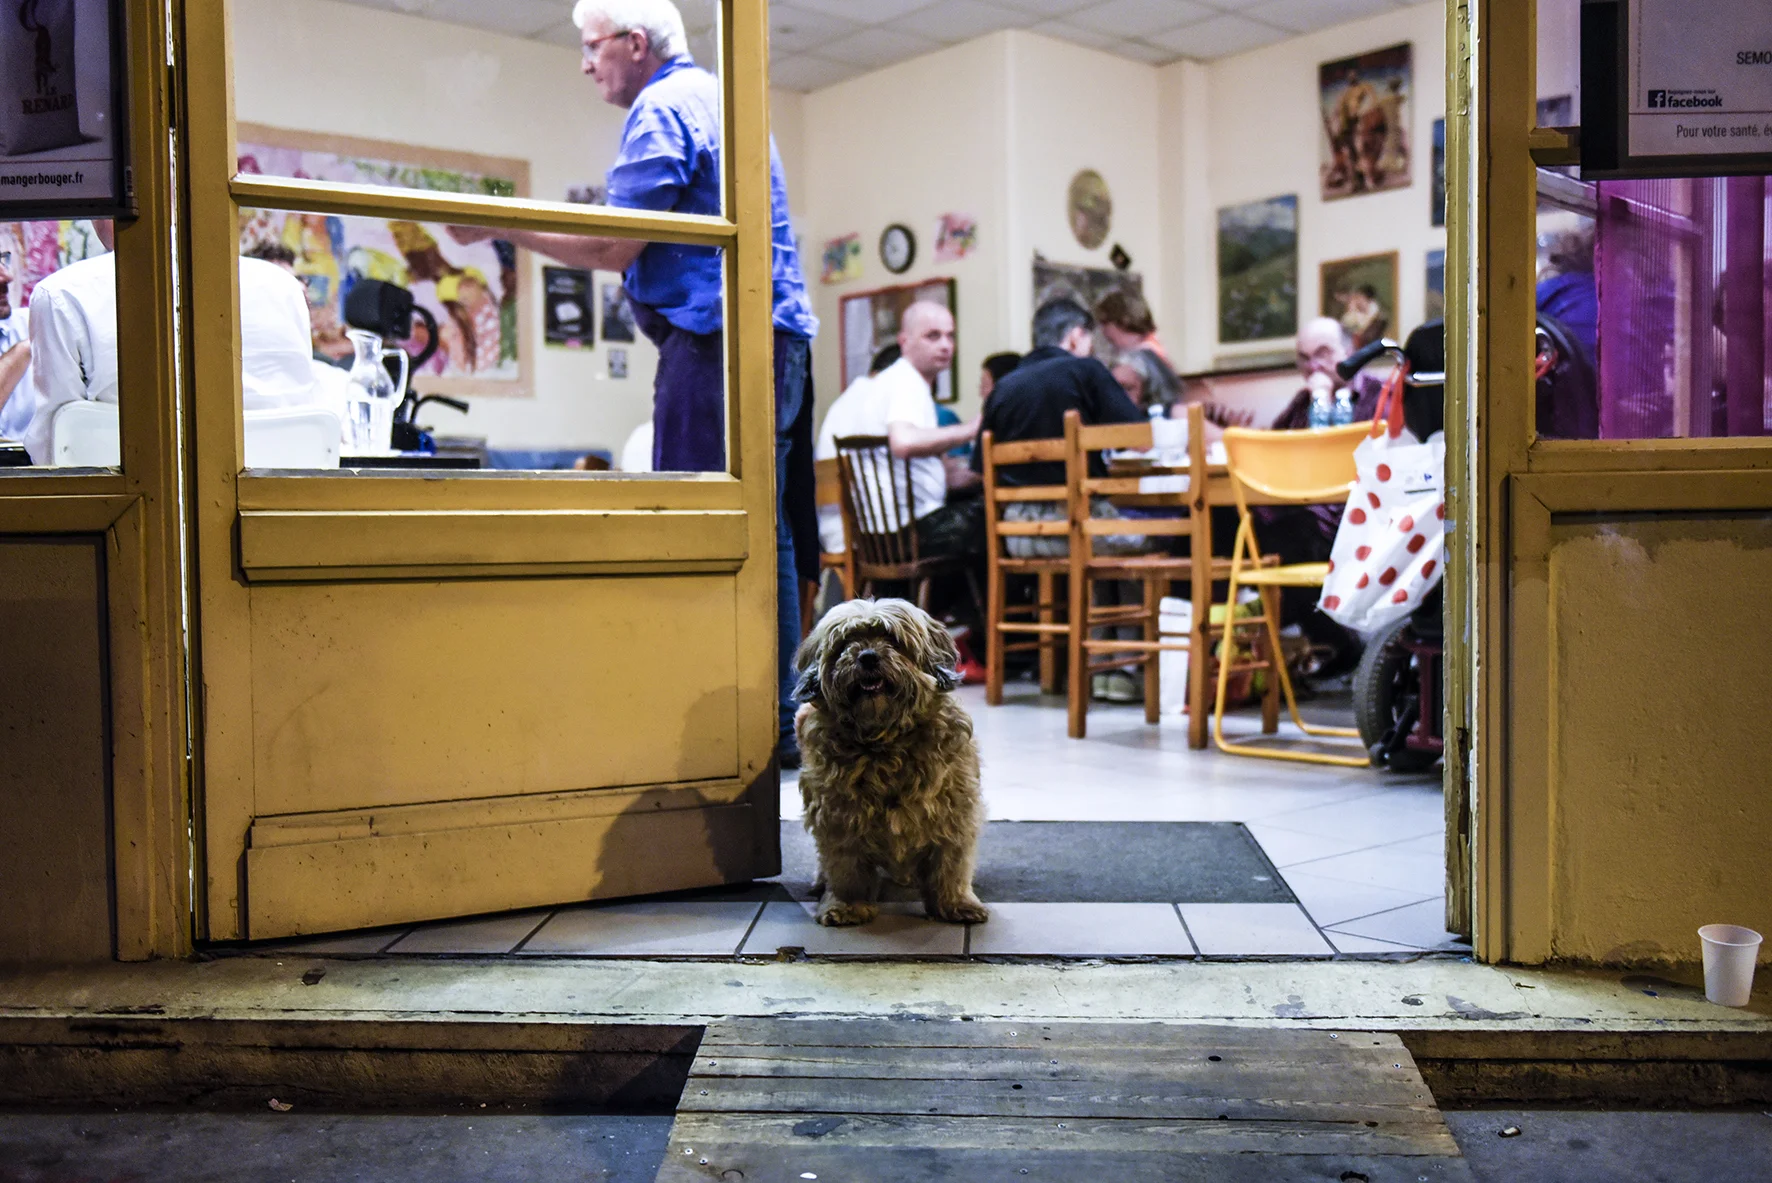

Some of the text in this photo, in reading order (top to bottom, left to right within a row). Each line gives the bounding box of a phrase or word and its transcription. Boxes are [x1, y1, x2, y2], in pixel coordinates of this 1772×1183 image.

[1668, 95, 1723, 107] facebook
[1676, 125, 1699, 138] Pour
[1702, 125, 1727, 137] votre
[1, 171, 84, 187] mangerbouger.fr
